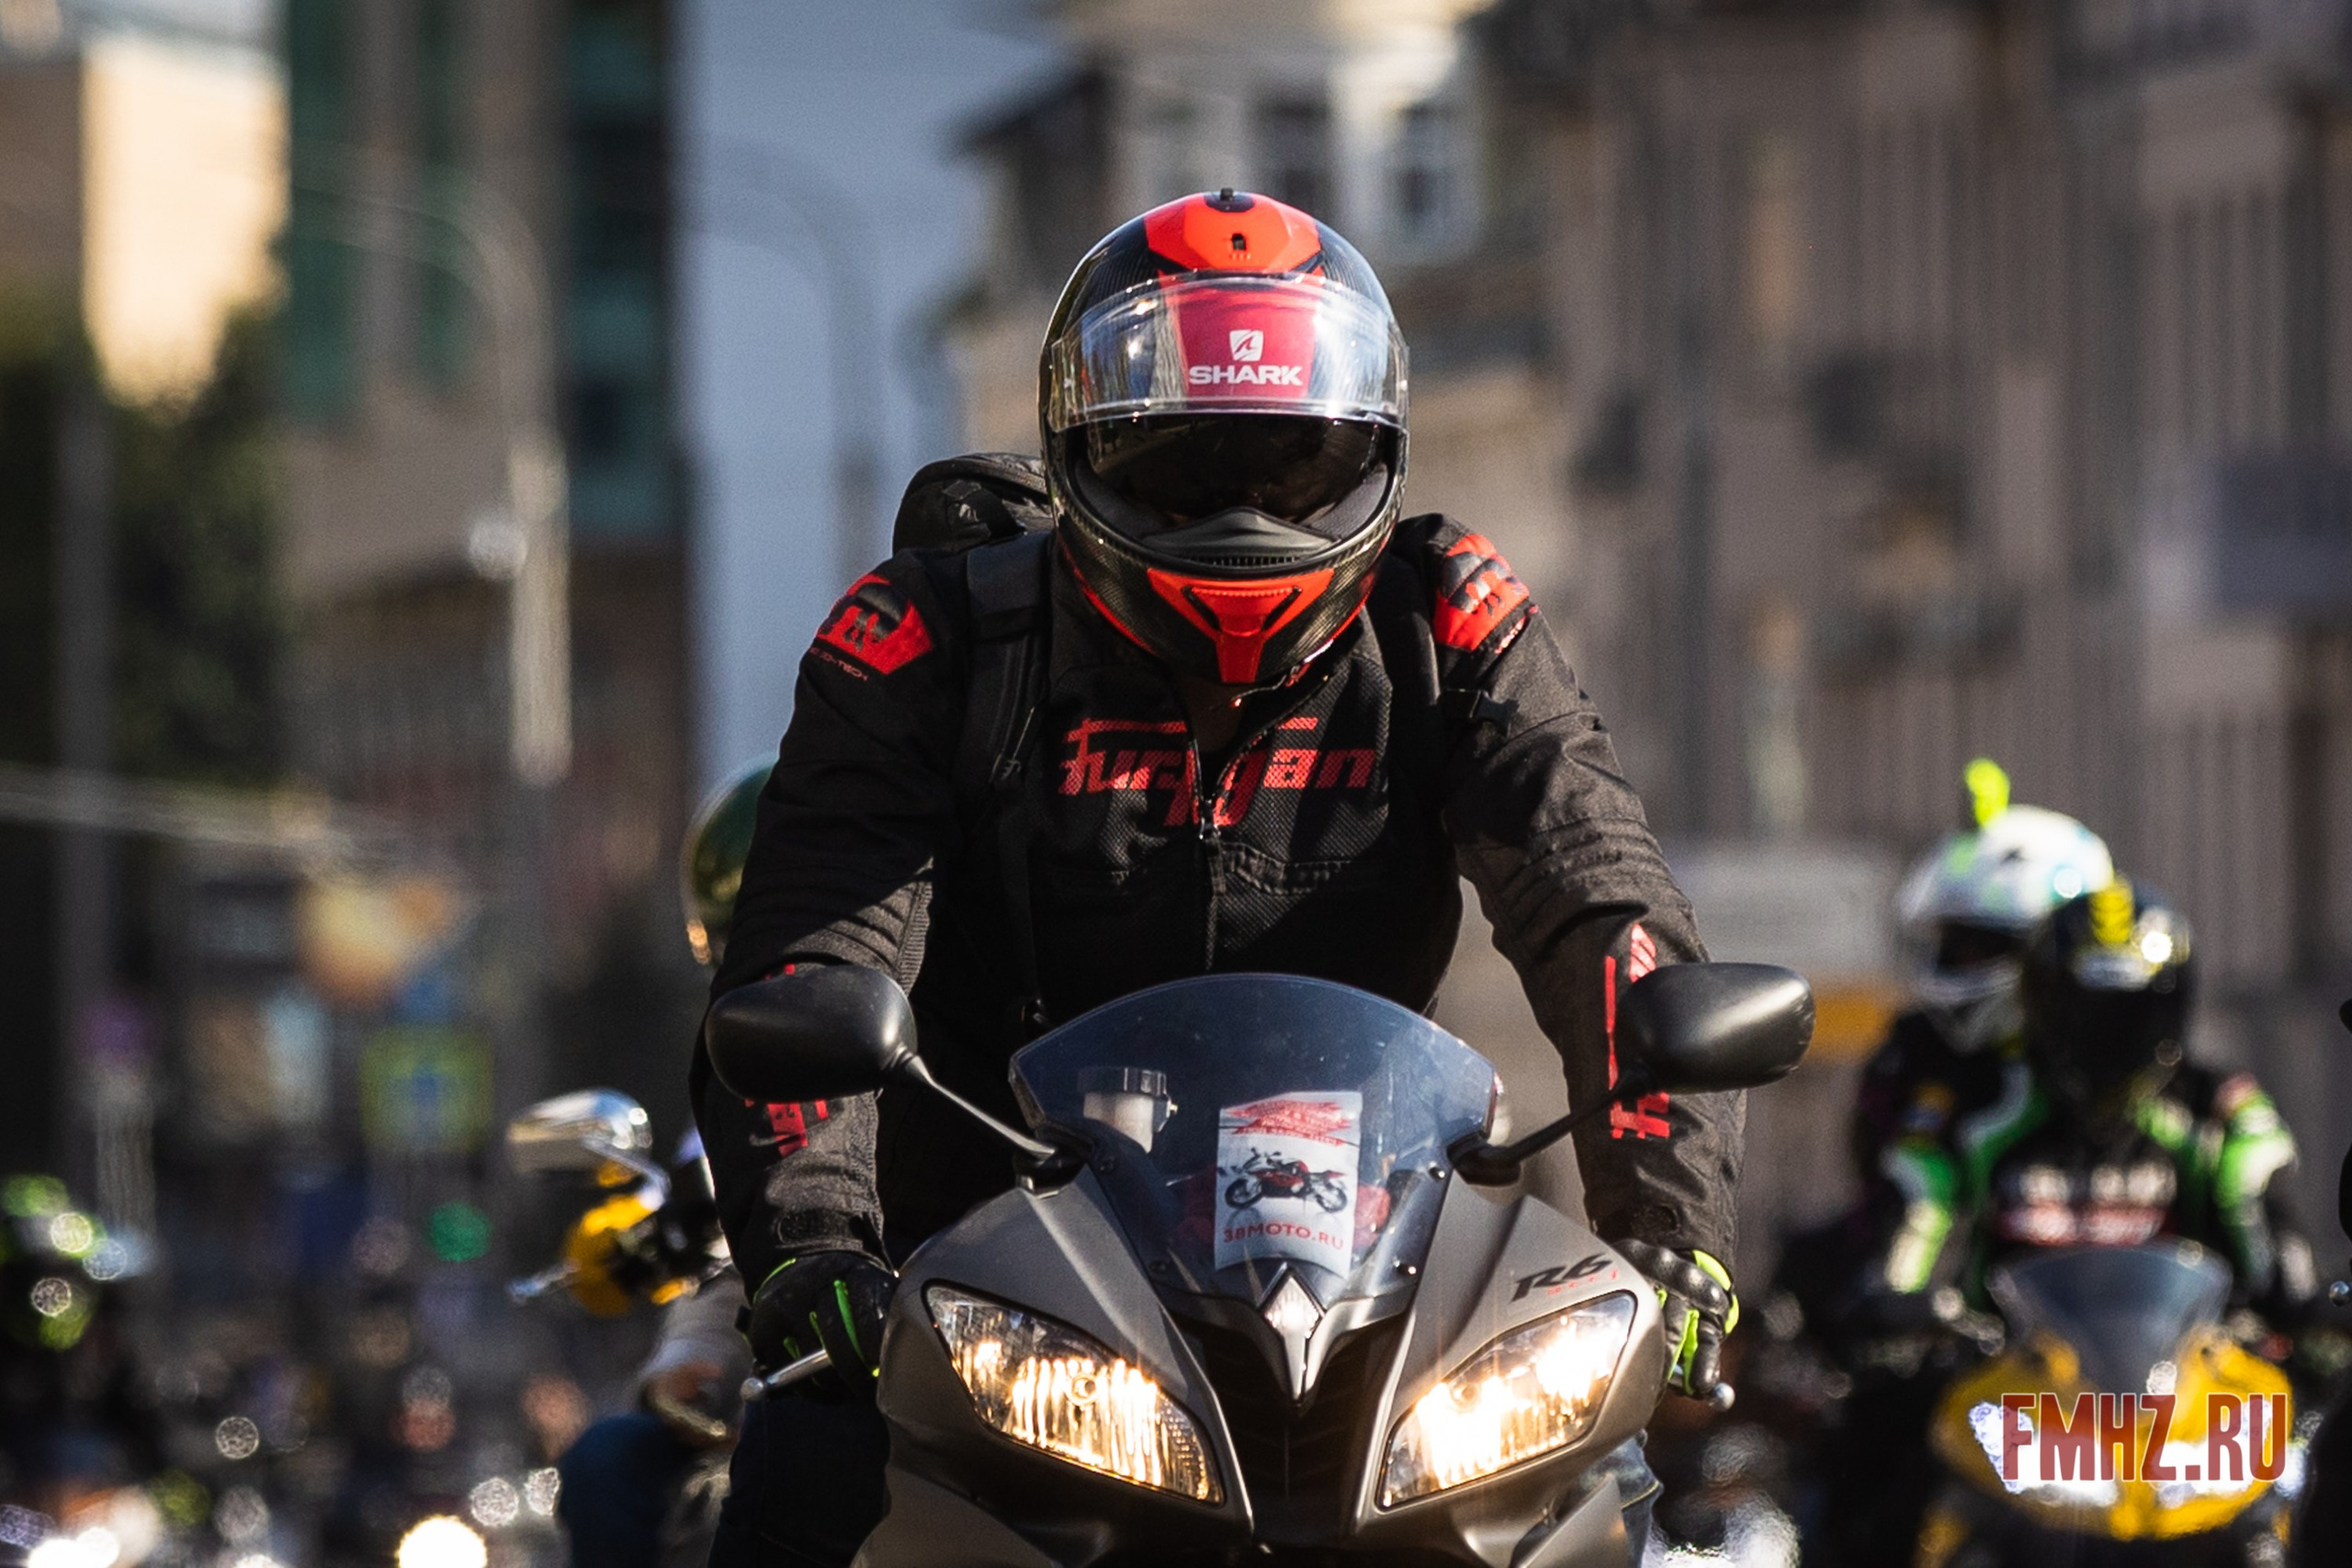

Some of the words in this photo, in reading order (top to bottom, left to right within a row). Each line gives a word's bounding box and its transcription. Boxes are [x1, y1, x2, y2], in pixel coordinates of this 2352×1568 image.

[1189, 366, 1303, 386] SHARK
[1223, 1220, 1344, 1250] 38MOTO.RU
[1510, 1253, 1613, 1303] R6
